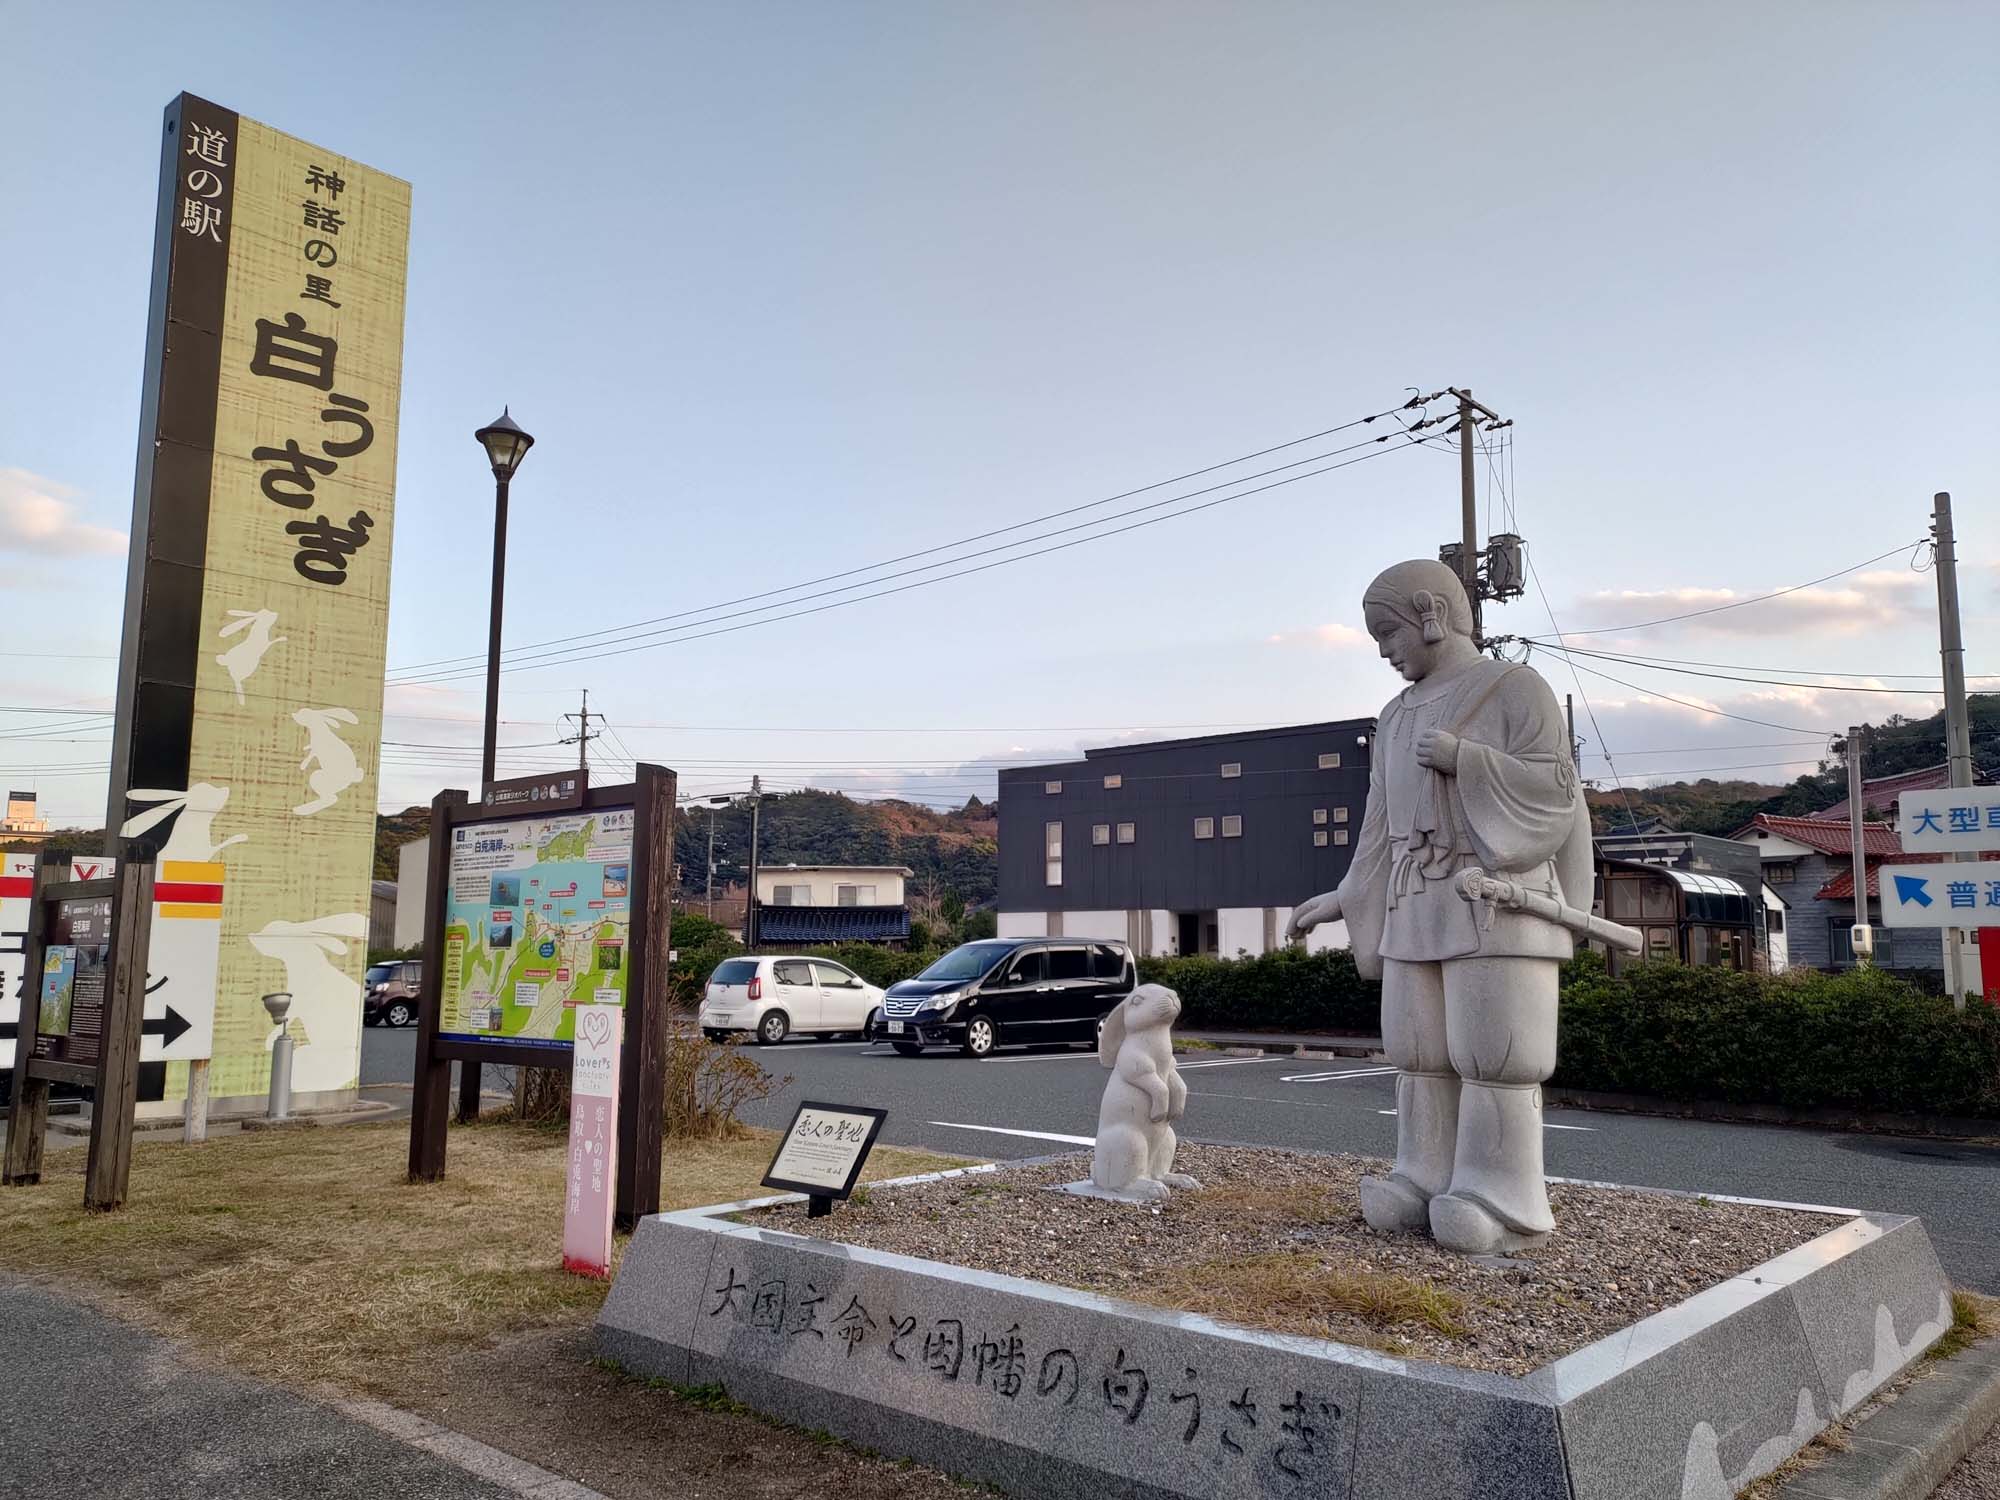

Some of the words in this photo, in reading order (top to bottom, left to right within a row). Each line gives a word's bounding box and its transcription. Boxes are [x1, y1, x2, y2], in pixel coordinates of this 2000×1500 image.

[181, 121, 229, 242] 道の駅
[300, 164, 345, 308] 神話の里
[250, 311, 374, 585] 白うさぎ
[592, 1105, 605, 1193] 恋人の聖地
